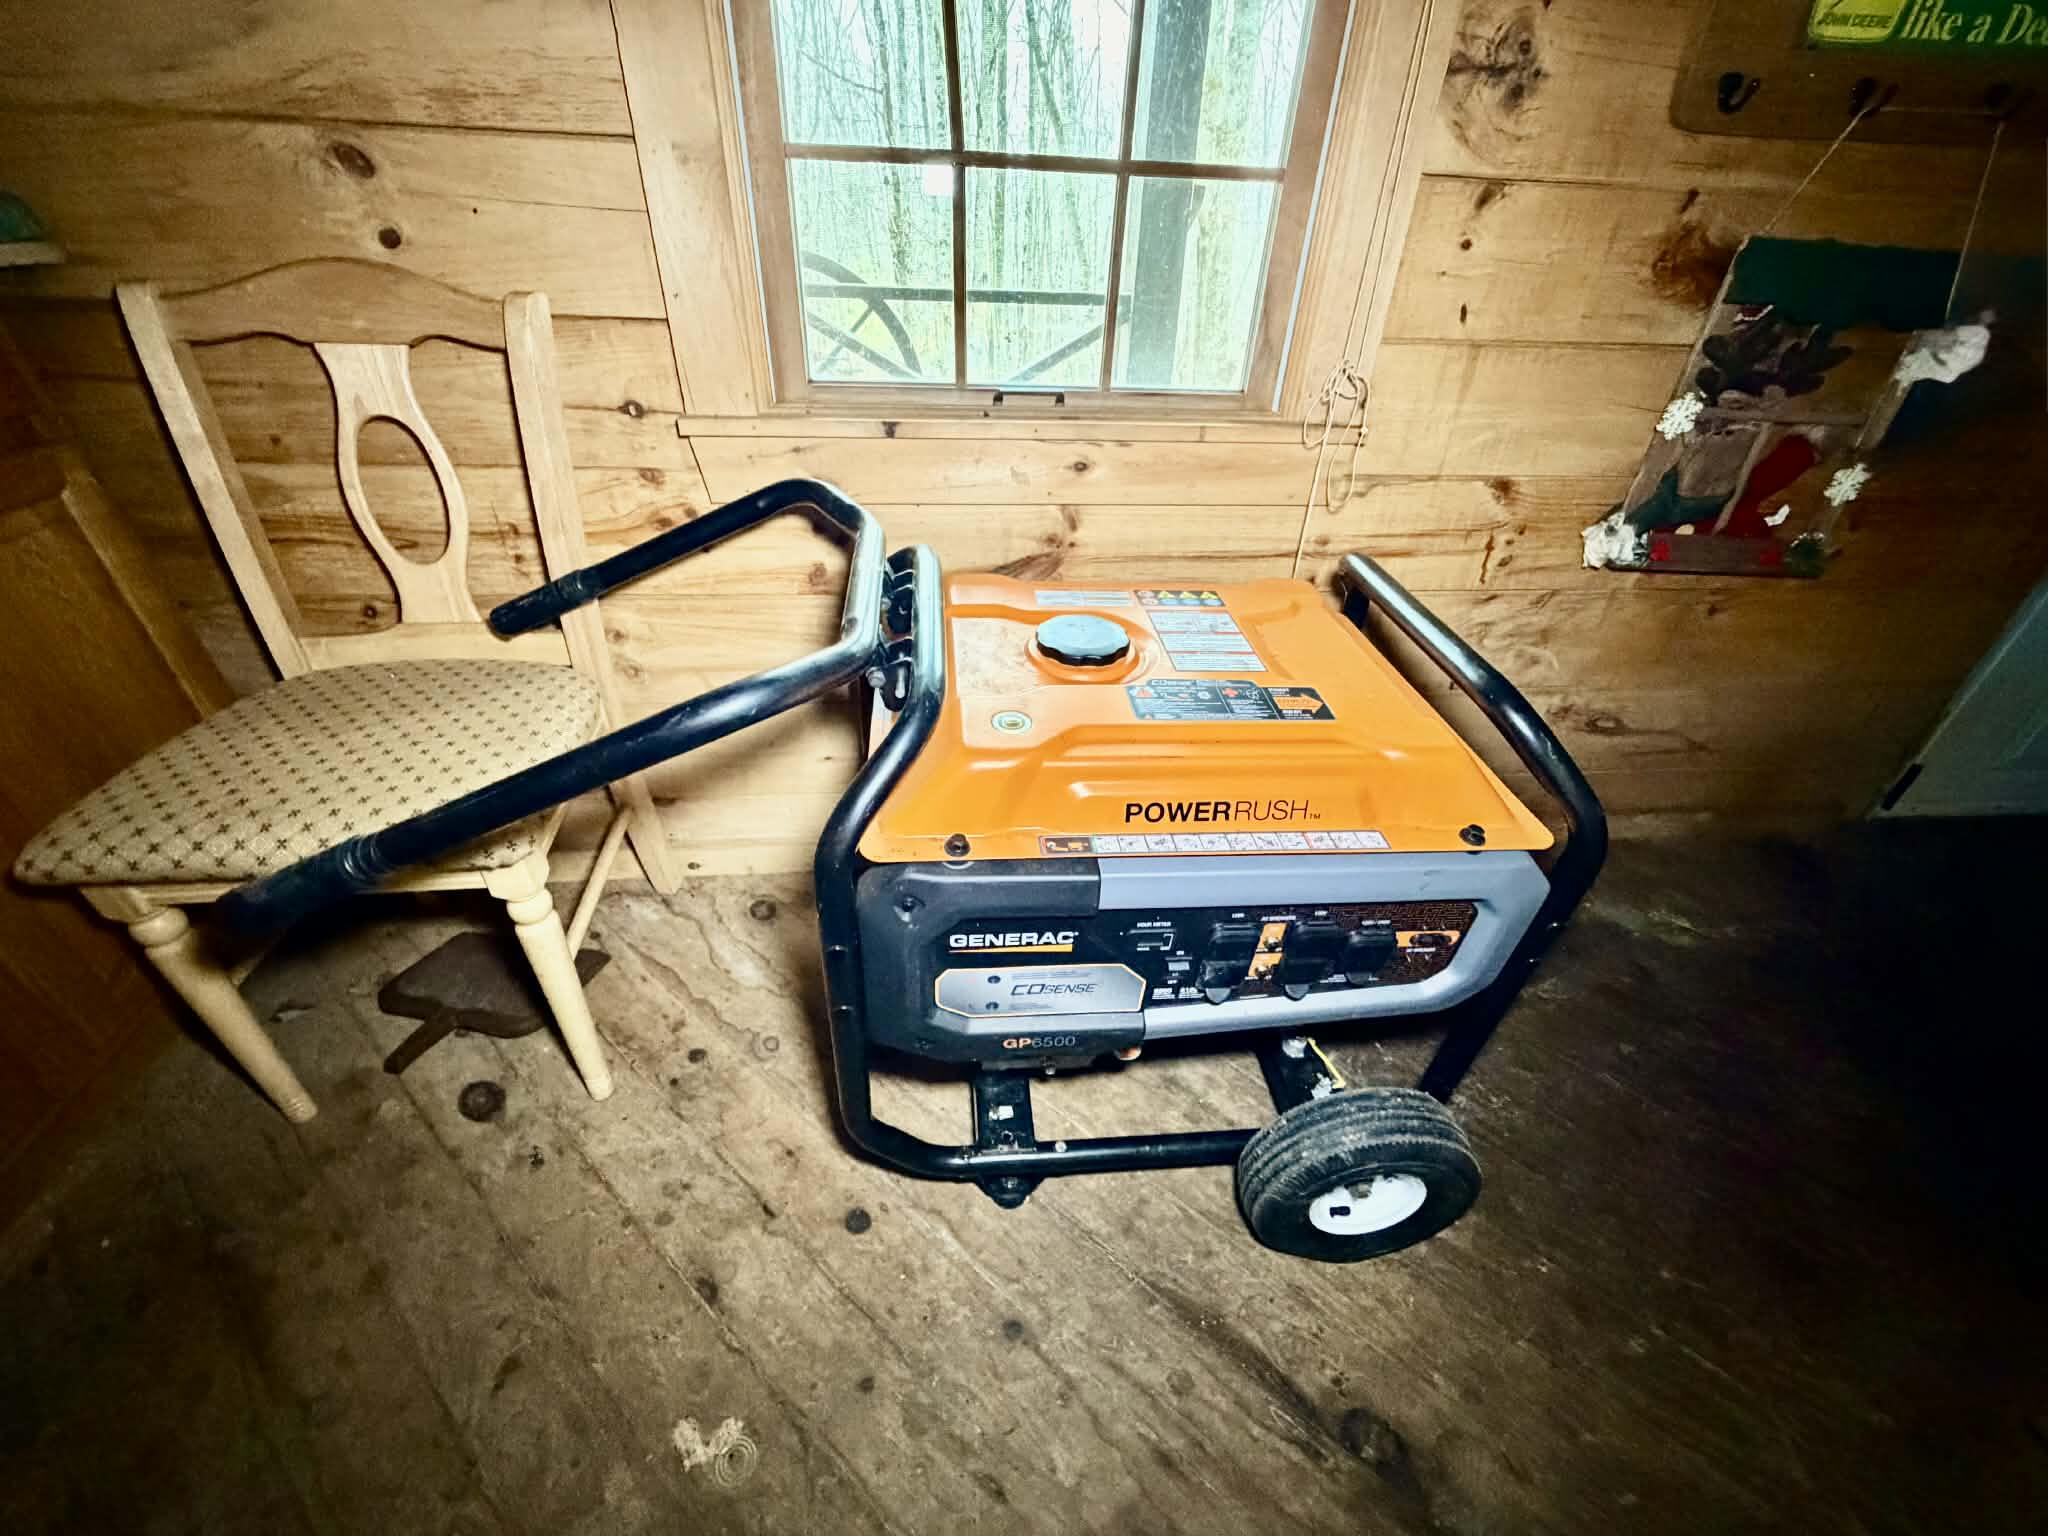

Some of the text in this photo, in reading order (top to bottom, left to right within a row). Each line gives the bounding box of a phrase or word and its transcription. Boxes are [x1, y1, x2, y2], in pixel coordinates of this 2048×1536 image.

[1899, 0, 1963, 40] like
[1966, 14, 1992, 43] a
[1124, 799, 1309, 824] POWERRUSH
[949, 931, 1075, 949] GENERAC
[1002, 1035, 1076, 1050] GP6500
